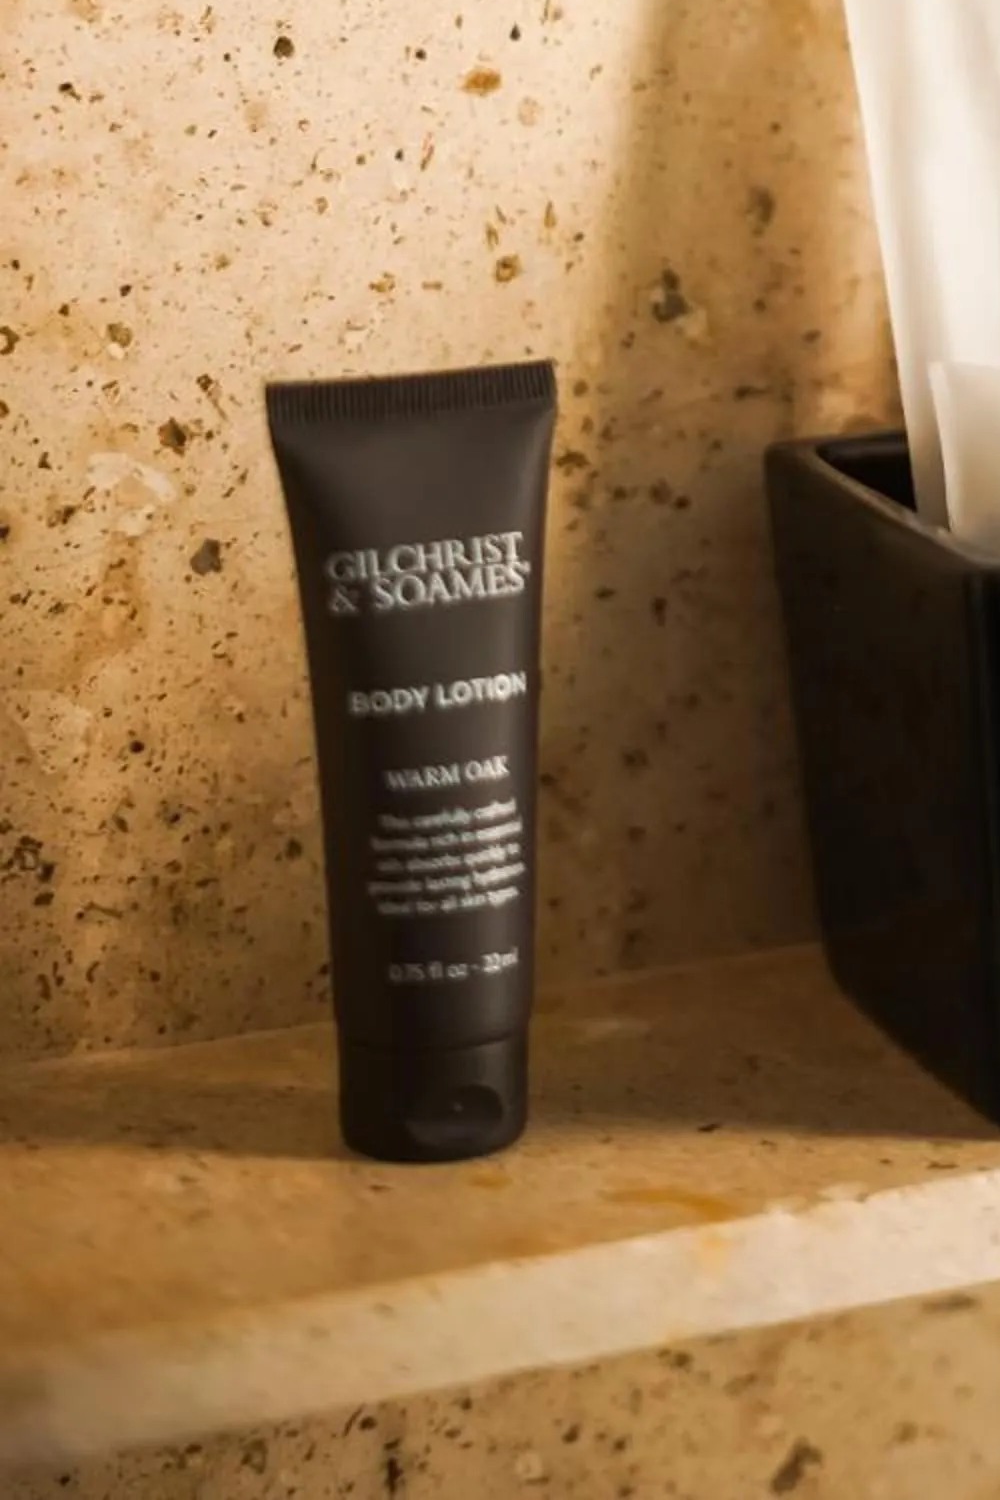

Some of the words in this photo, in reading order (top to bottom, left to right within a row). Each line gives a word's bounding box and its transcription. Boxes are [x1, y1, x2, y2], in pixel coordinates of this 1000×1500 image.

[326, 531, 523, 580] GILCHRIST
[329, 585, 357, 612] &
[373, 560, 531, 610] SOAMES
[350, 685, 429, 715] BODY
[436, 671, 527, 707] LOTION
[387, 765, 460, 791] WARM
[465, 755, 510, 781] OAK
